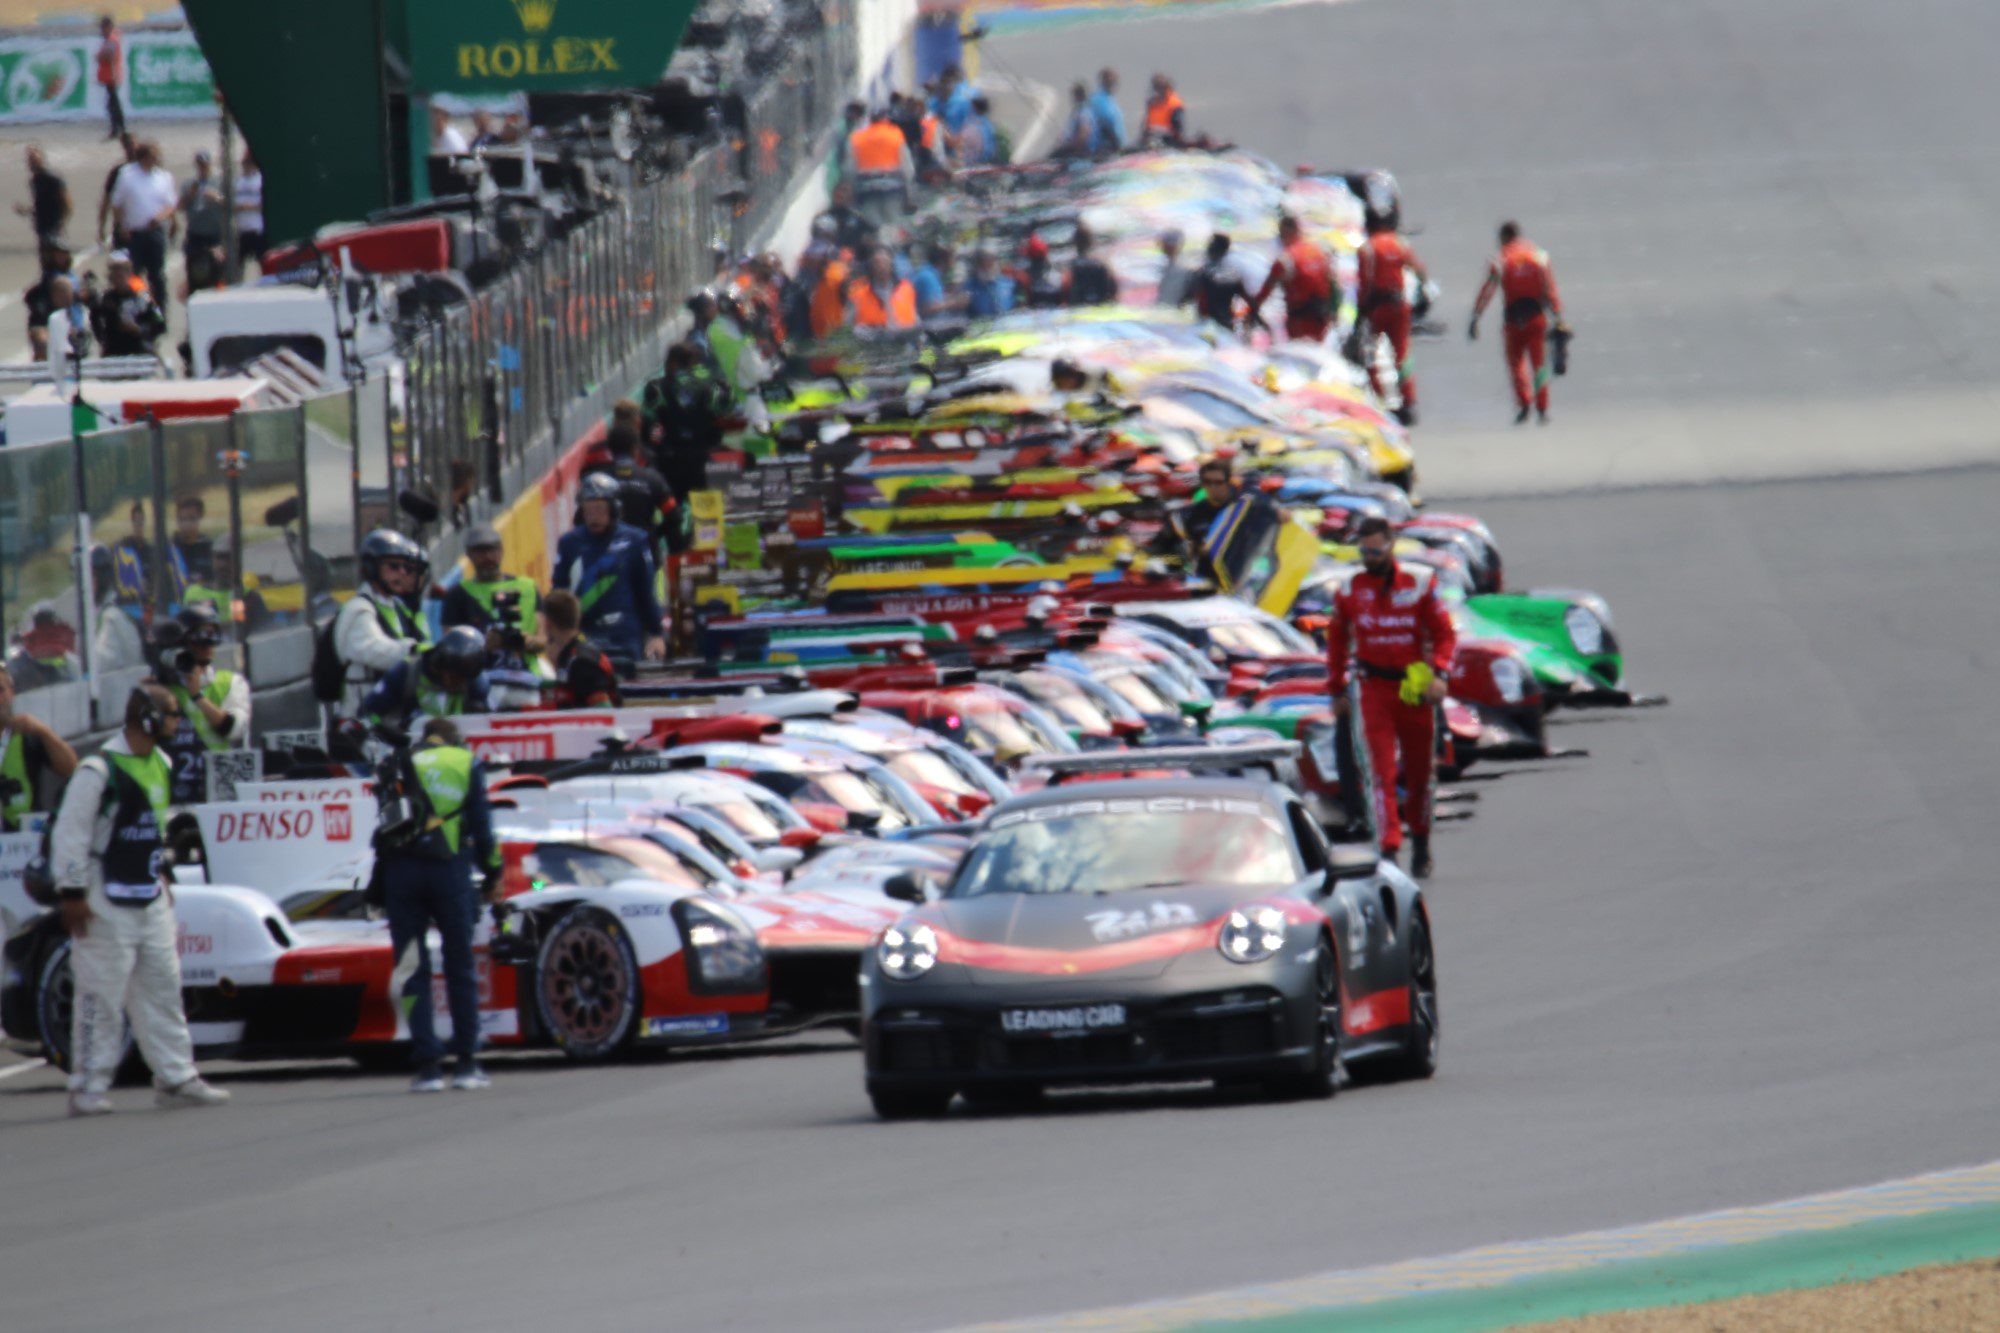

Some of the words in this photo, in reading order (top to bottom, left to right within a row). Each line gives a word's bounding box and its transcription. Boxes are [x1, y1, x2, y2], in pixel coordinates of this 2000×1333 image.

[458, 37, 619, 77] ROLEX
[216, 809, 314, 842] DENSO
[1001, 1007, 1085, 1031] LEADING
[1085, 1003, 1126, 1027] CAR
